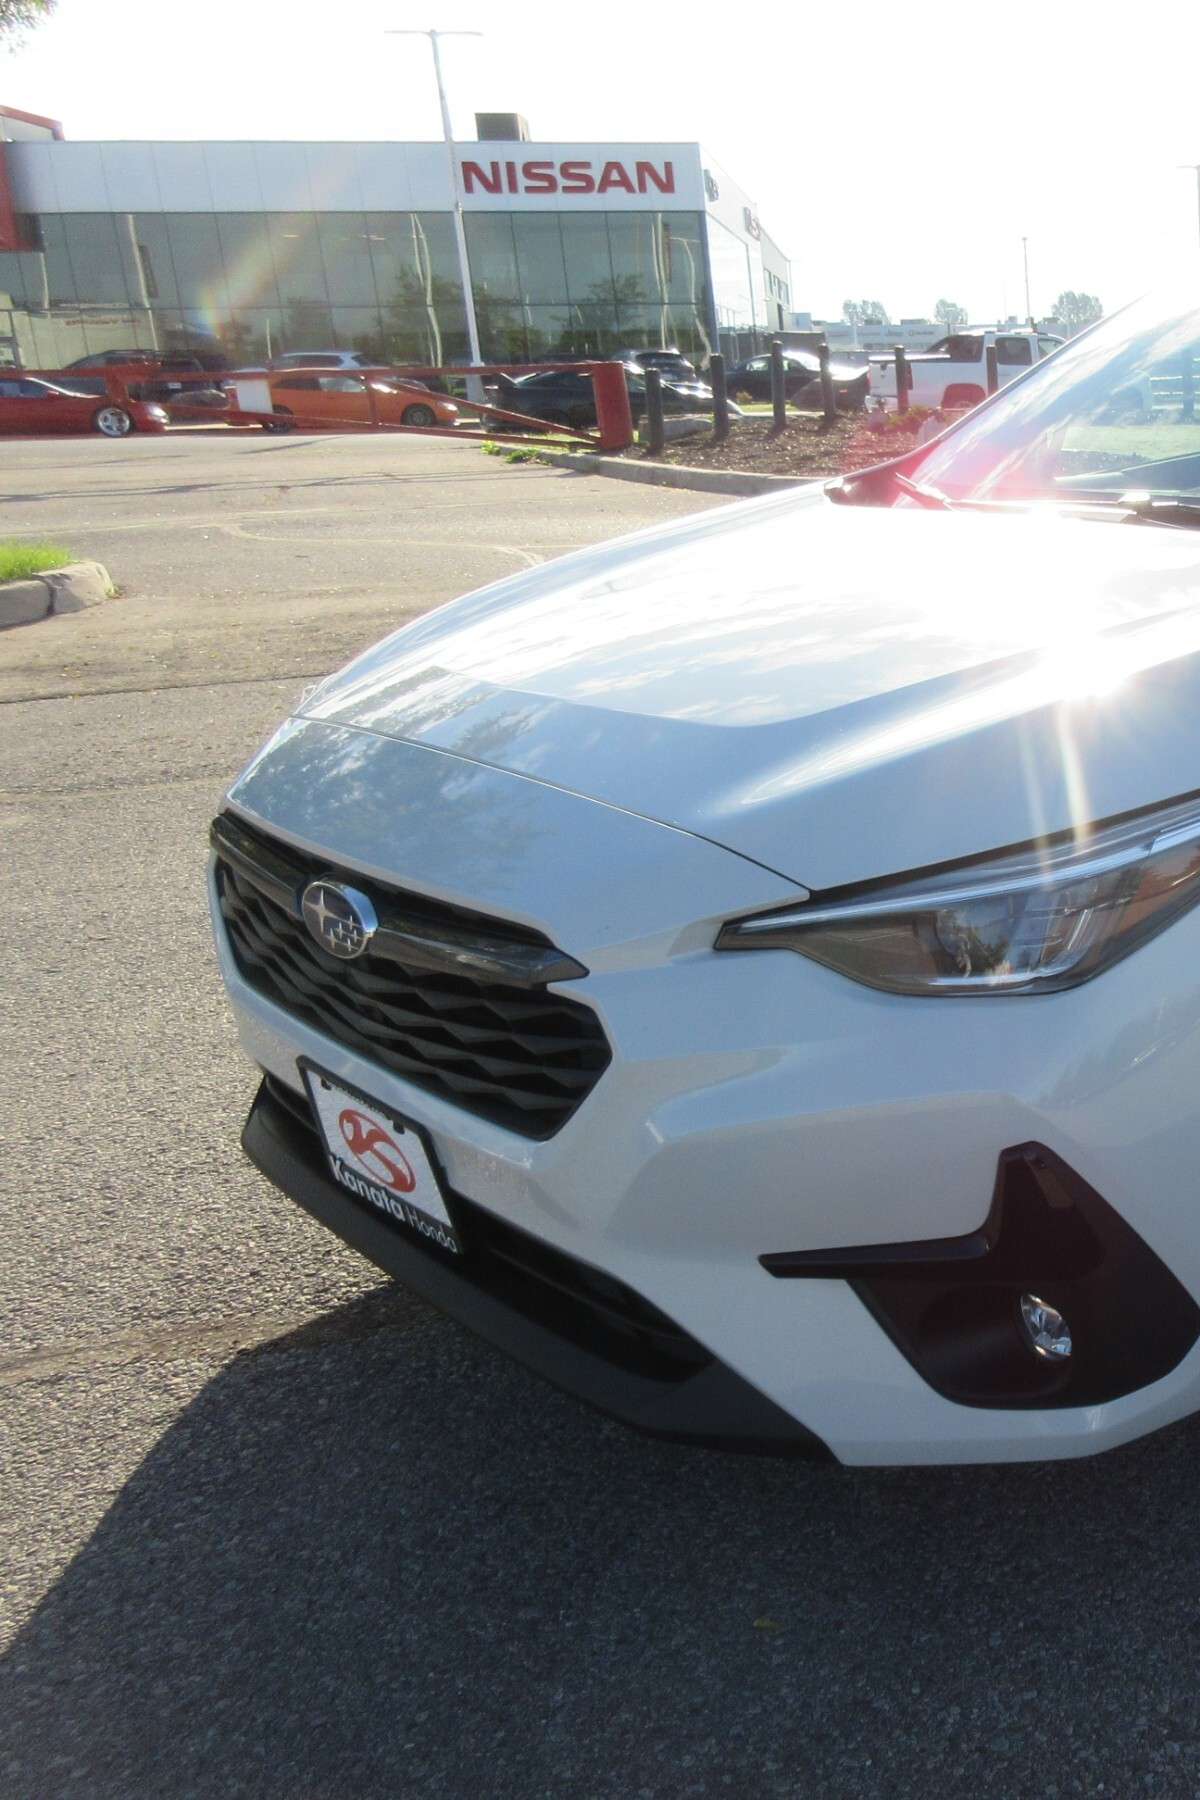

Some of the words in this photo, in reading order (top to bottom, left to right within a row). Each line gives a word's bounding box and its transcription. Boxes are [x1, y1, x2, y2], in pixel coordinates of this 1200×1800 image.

[461, 161, 675, 194] NISSAN
[329, 1155, 405, 1222] Kanata
[404, 1205, 458, 1254] Honda
